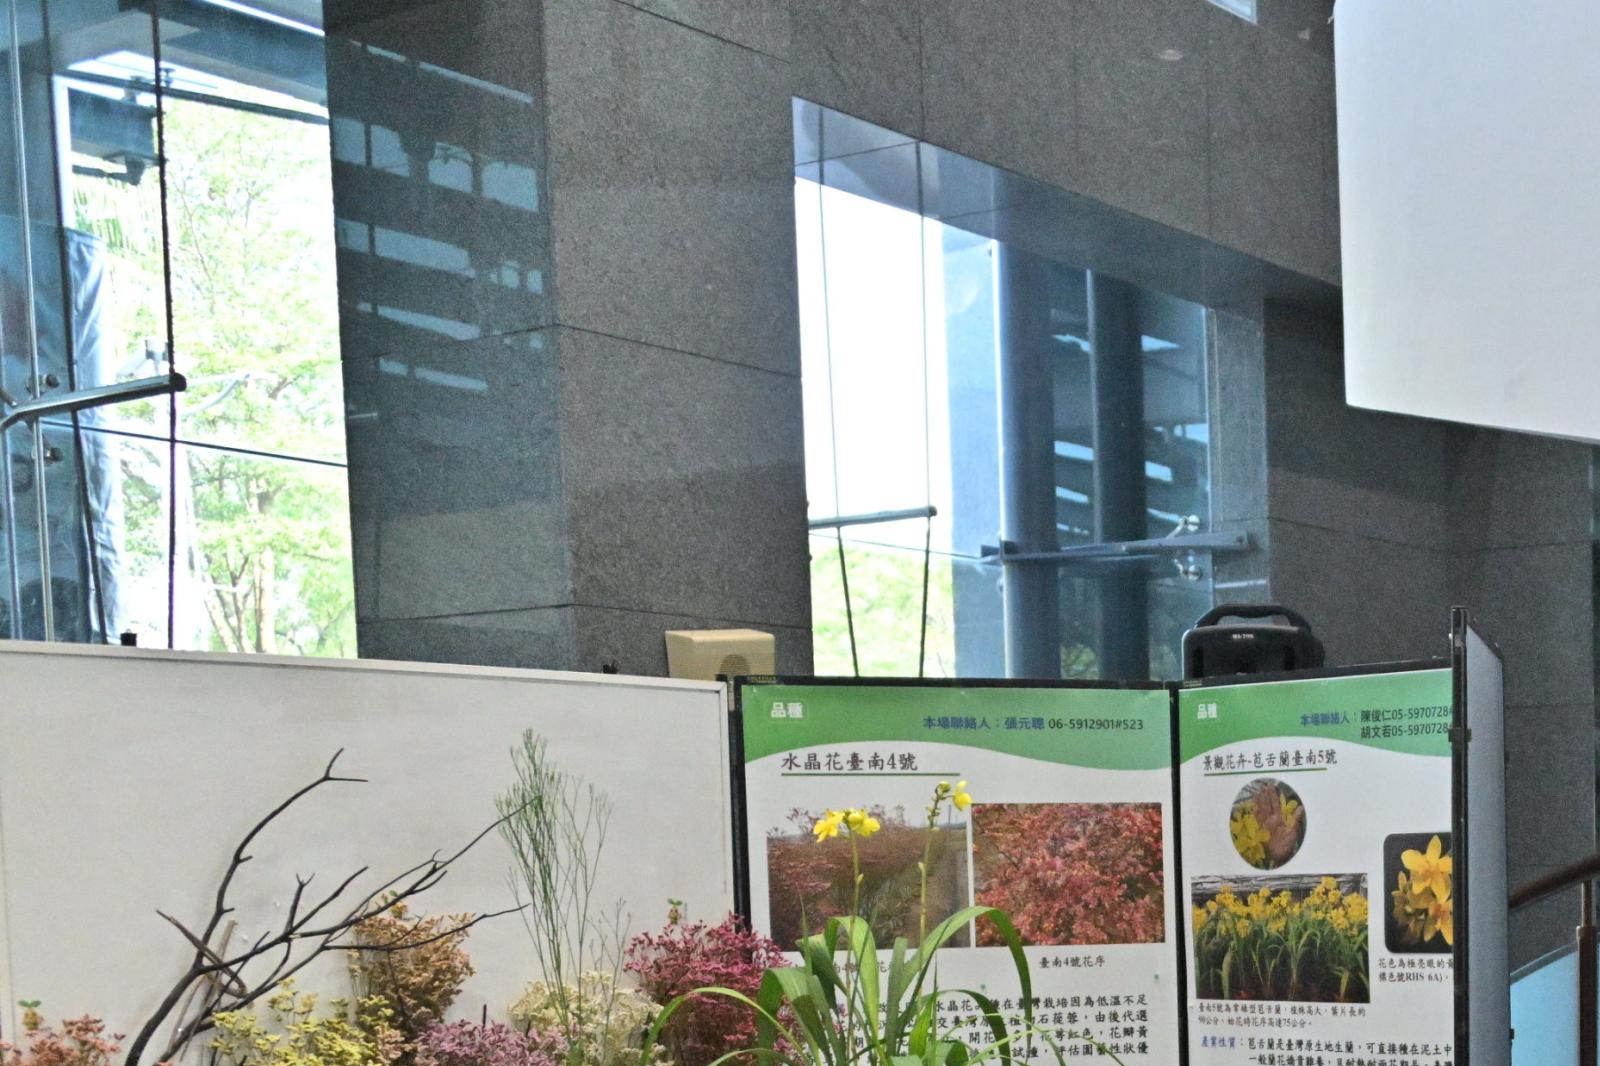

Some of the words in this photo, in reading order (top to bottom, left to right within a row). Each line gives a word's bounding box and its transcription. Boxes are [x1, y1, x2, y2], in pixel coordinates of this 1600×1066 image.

[771, 702, 803, 718] 品種
[1197, 703, 1218, 719] 品種
[1048, 718, 1144, 732] 06-5912901#523
[1360, 722, 1451, 739] 胡文若05-5970728
[781, 751, 918, 772] 水晶花臺南4號
[1039, 956, 1106, 969] 臺南4號花序
